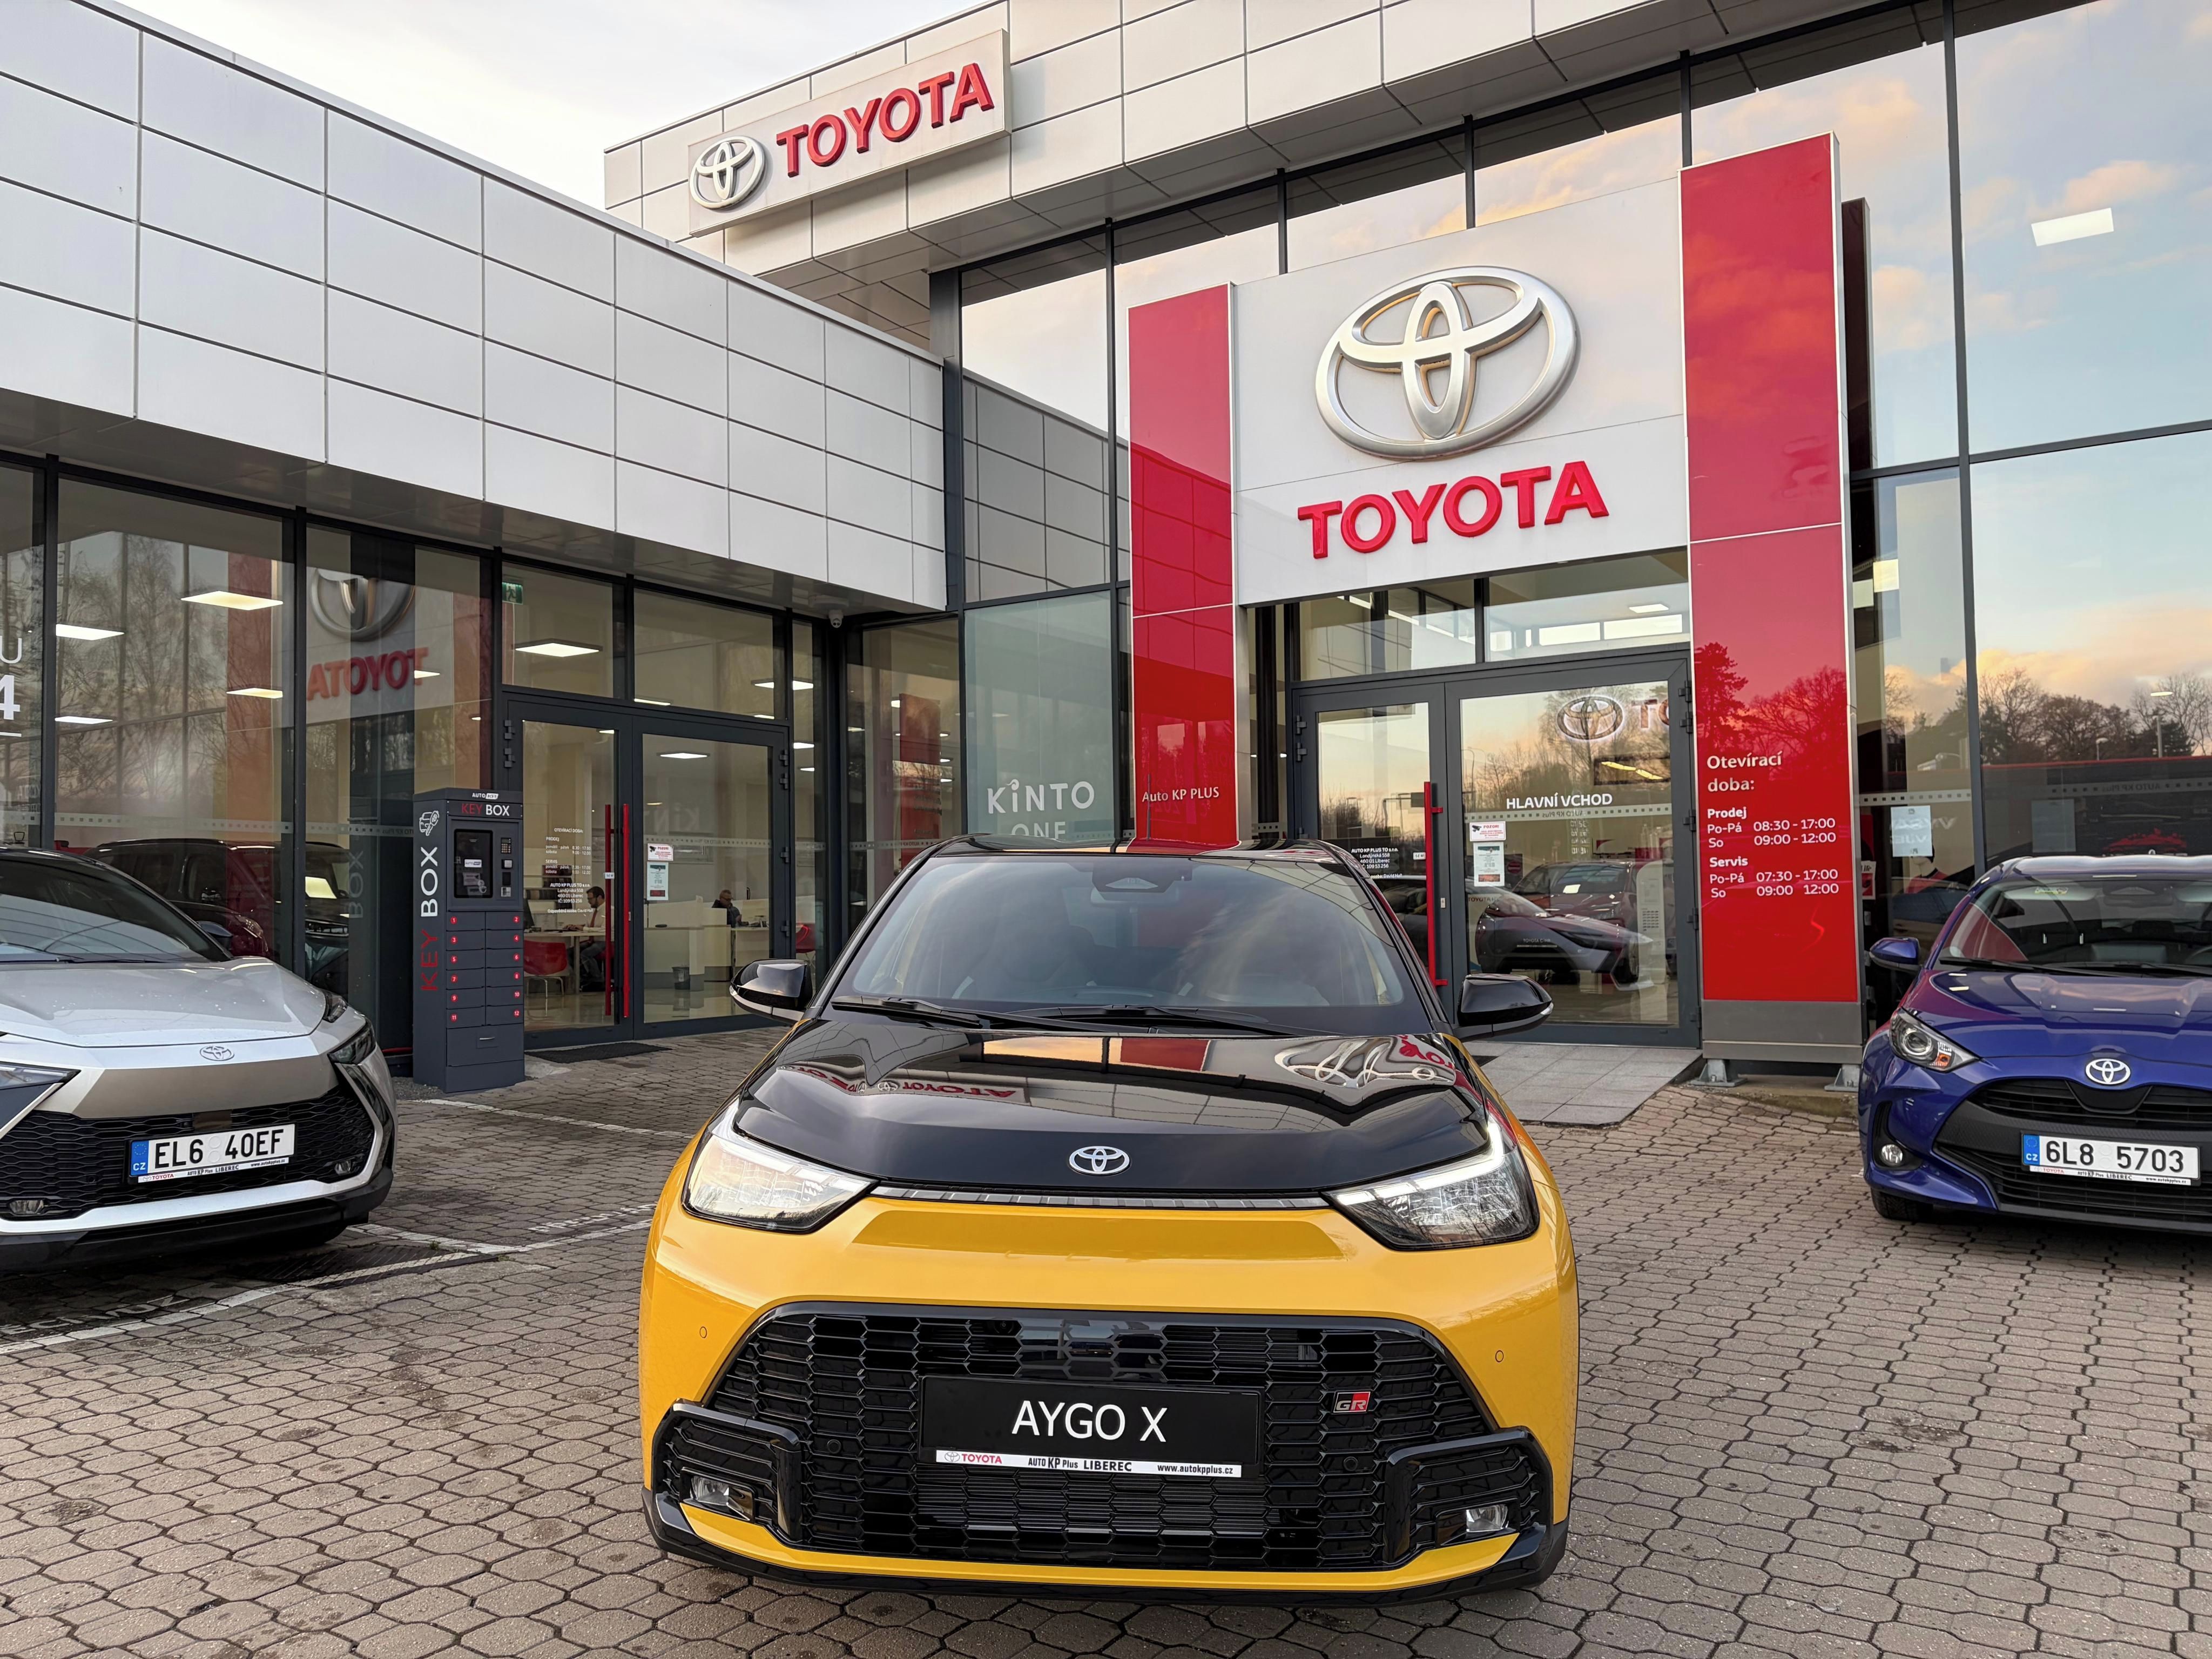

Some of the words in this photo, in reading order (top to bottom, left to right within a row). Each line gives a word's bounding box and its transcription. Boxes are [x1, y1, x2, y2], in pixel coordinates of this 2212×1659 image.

[777, 63, 994, 178] TOYOTA
[1297, 461, 1609, 559] TOYOTA
[1707, 751, 1783, 769] Otevírací
[1708, 777, 1755, 792] doba:
[1142, 791, 1168, 802] Auto
[1172, 789, 1187, 800] KP
[1190, 786, 1219, 799] PLUS
[1506, 792, 1559, 810] HLAVNÍ
[1561, 793, 1613, 807] VCHOD
[461, 803, 483, 814] KEY
[485, 804, 510, 816] BOX
[1707, 806, 1747, 819] Prodej
[1707, 822, 1742, 834] Po-Pá
[1753, 820, 1790, 832] 08:30
[1800, 818, 1836, 830] 17:00
[1708, 838, 1724, 848] So
[1754, 834, 1791, 846] 09:00
[1801, 832, 1836, 844] 12:00
[1709, 856, 1749, 868] Servis
[420, 846, 438, 917] BOX
[1710, 872, 1745, 884] Po-Pá
[1756, 871, 1792, 882] 07:30
[1803, 869, 1838, 880] 17:00
[1711, 888, 1726, 898] So
[1756, 885, 1793, 896] 09:00
[1803, 884, 1839, 895] 12:00
[421, 929, 439, 991] KEY
[154, 1138, 204, 1169] EL6
[225, 1129, 284, 1159] 40EF
[2046, 1141, 2094, 1165] 6L8
[2116, 1146, 2184, 1172] 5703
[133, 1162, 146, 1171] CZ
[215, 1165, 239, 1173] LIBEREC
[1336, 1400, 1366, 1411] GR
[1011, 1400, 1125, 1441] AYGO
[1139, 1406, 1168, 1442] X
[962, 1454, 1002, 1465] TOYOTA
[1028, 1458, 1047, 1468] AUTO
[1048, 1456, 1061, 1469] KP
[1062, 1459, 1078, 1469] Plus
[1083, 1460, 1132, 1472] LIBEREC
[1157, 1464, 1234, 1475] www.autokpplus.cz
